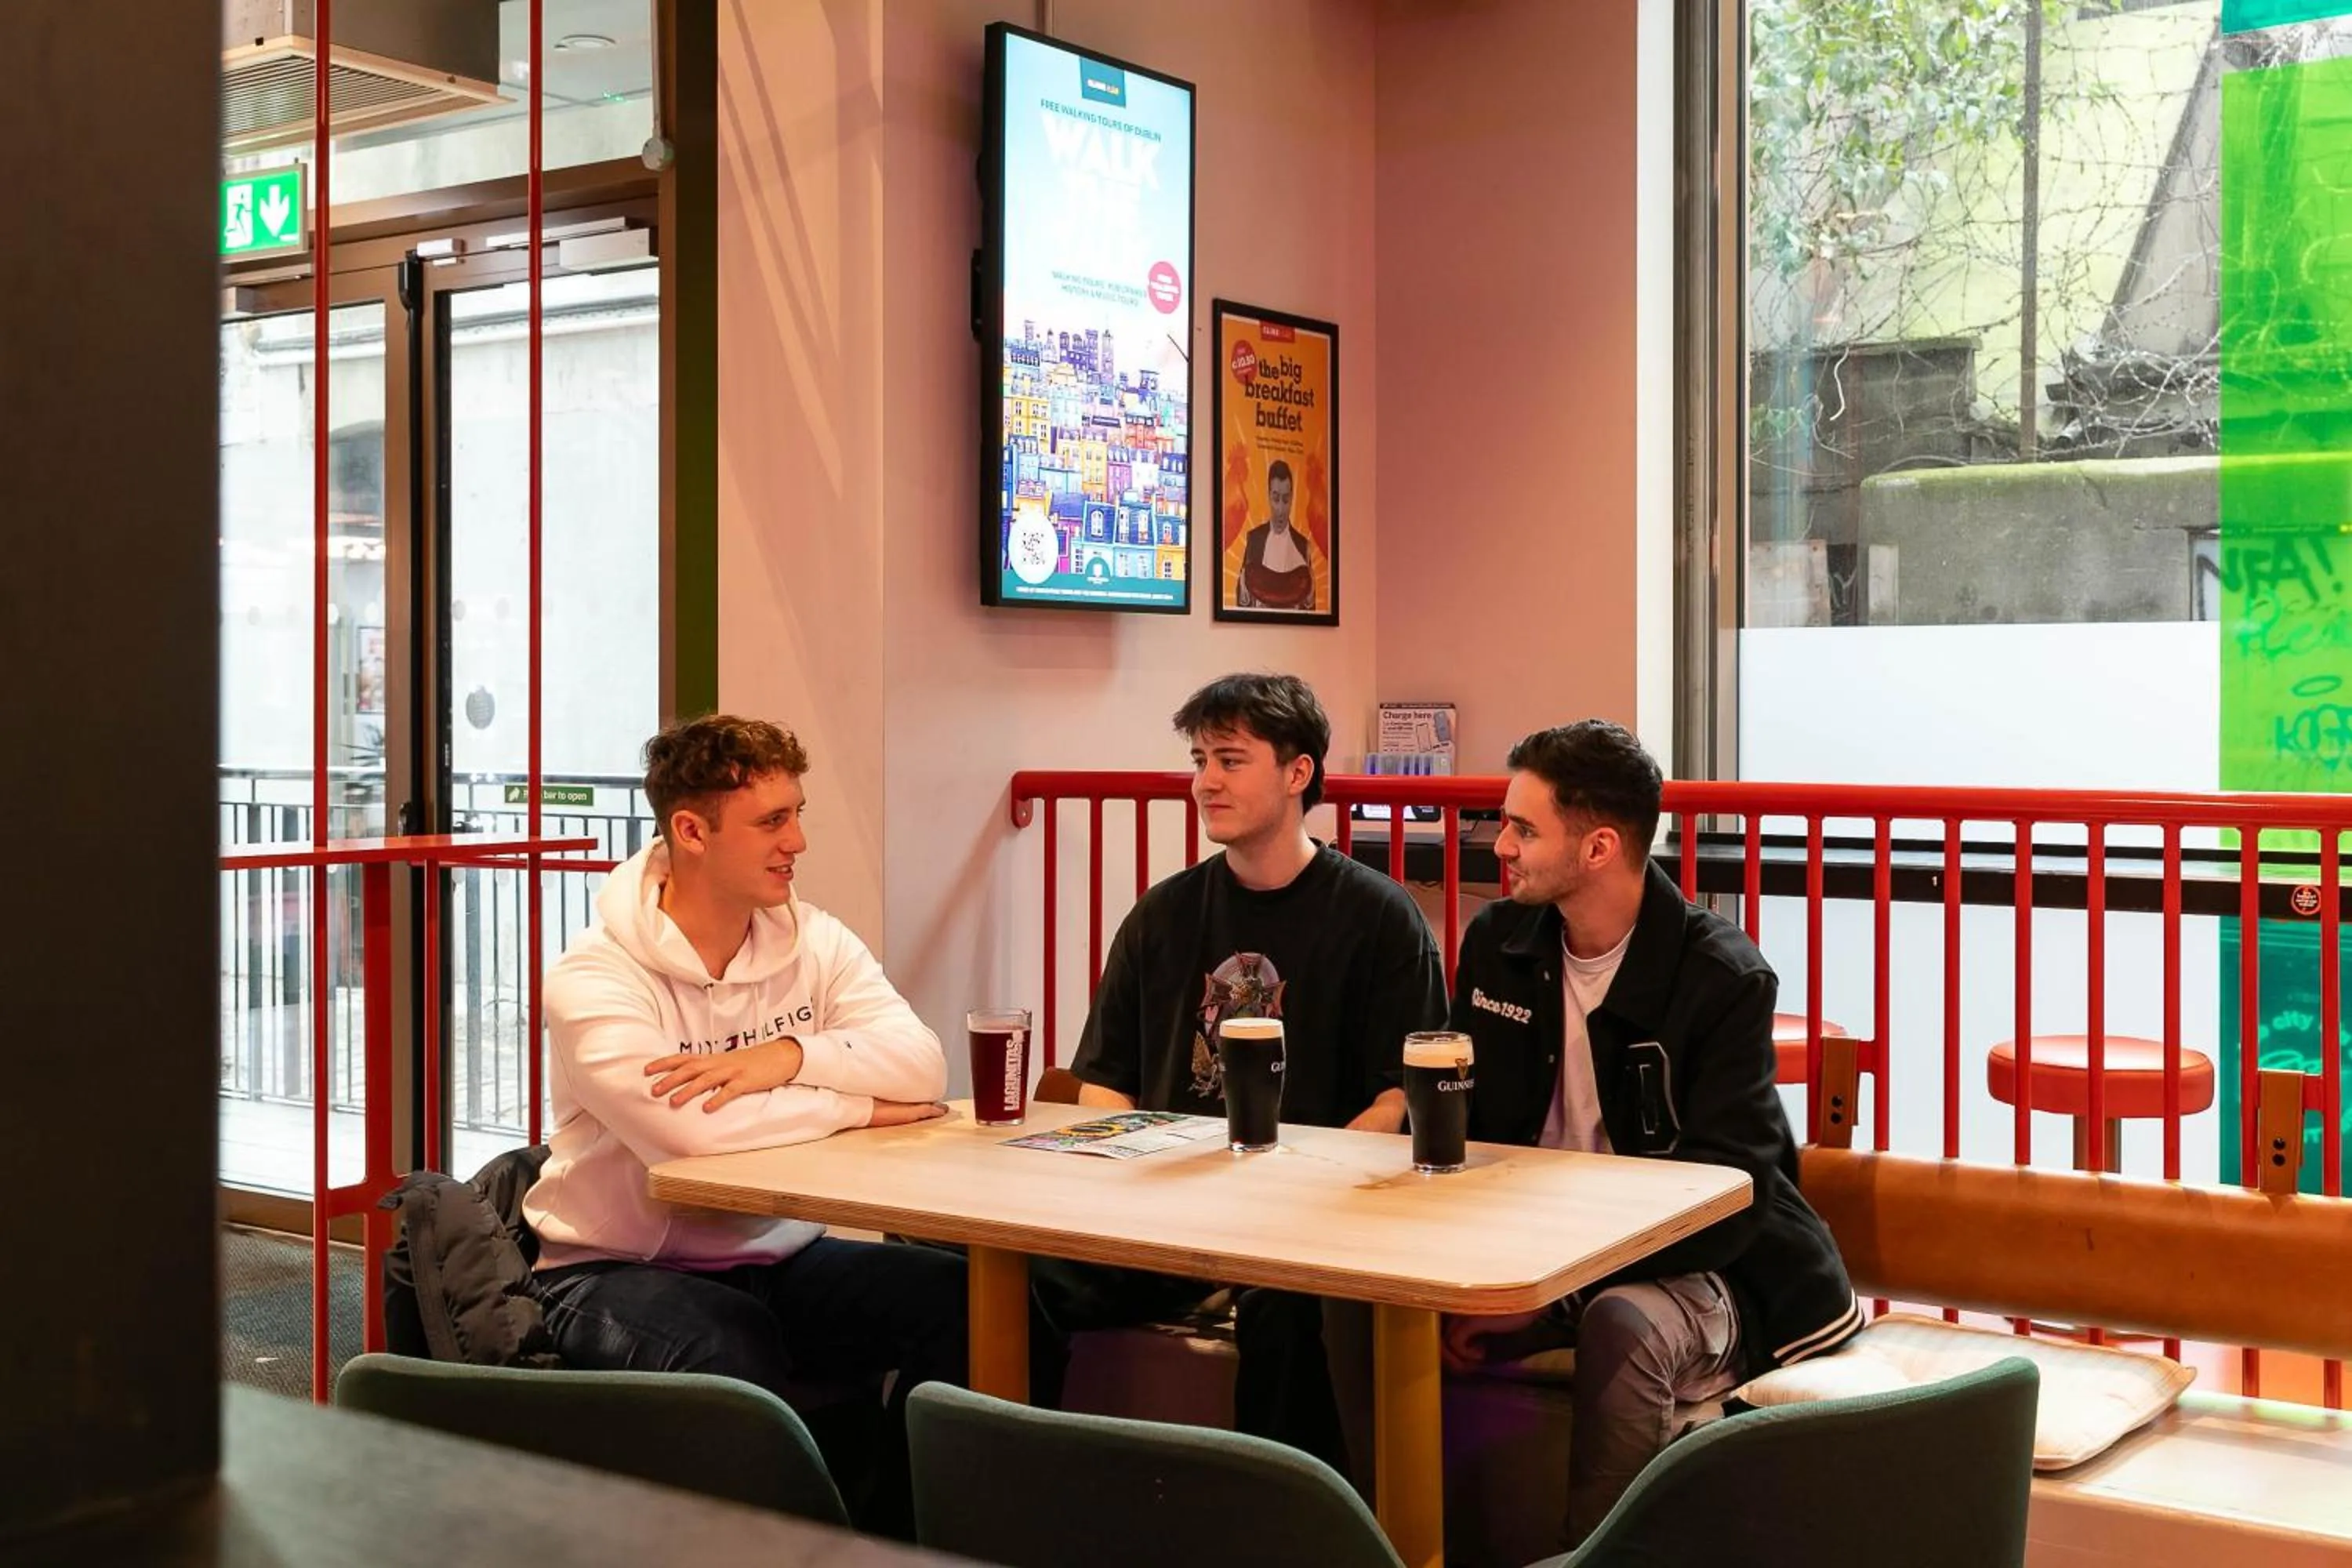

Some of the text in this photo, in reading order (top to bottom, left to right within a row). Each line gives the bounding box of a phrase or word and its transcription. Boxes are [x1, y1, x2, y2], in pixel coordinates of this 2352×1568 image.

[1040, 97, 1162, 143] FREE WALKING TOURS OF DUBLIN
[1258, 355, 1302, 384] the big
[1244, 373, 1315, 408] breakfast
[1255, 402, 1303, 432] buffet
[1382, 711, 1412, 720] Charge
[543, 789, 557, 799] bar
[558, 790, 566, 800] to
[567, 793, 587, 802] open
